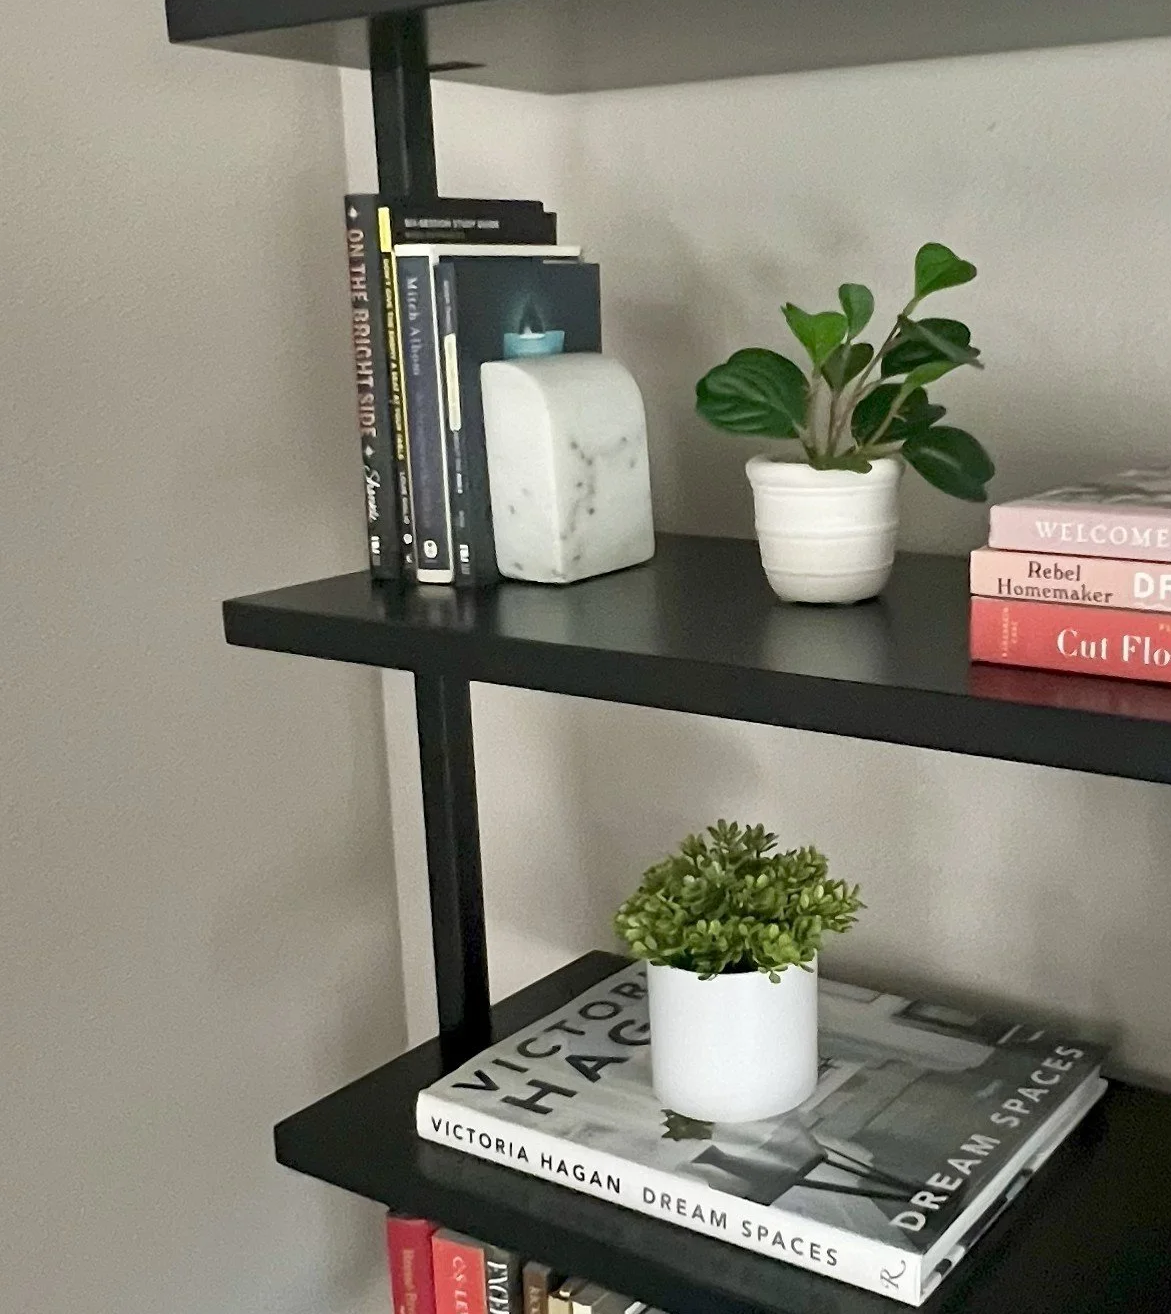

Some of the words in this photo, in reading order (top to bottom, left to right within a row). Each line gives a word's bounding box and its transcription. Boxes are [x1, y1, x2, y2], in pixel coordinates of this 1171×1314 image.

[348, 229, 365, 257] ON
[350, 263, 369, 303] THE
[406, 276, 419, 321] Mitch
[353, 308, 375, 388] BRIGHT
[409, 327, 424, 376] Albom
[358, 394, 377, 437] SIDE
[1035, 520, 1170, 548] WELCOME
[997, 577, 1114, 604] Homemaker
[1028, 560, 1082, 582] Rebel
[1056, 628, 1108, 660] Cut
[452, 971, 648, 1091] VICTOR
[501, 1019, 652, 1115] HAG
[889, 1133, 1001, 1232] DREAM
[990, 1045, 1084, 1129] SPACES
[431, 1116, 529, 1163] VICTORIA
[541, 1152, 621, 1194] HAGAN
[643, 1186, 727, 1230] DREAM
[742, 1219, 838, 1266] SPACES
